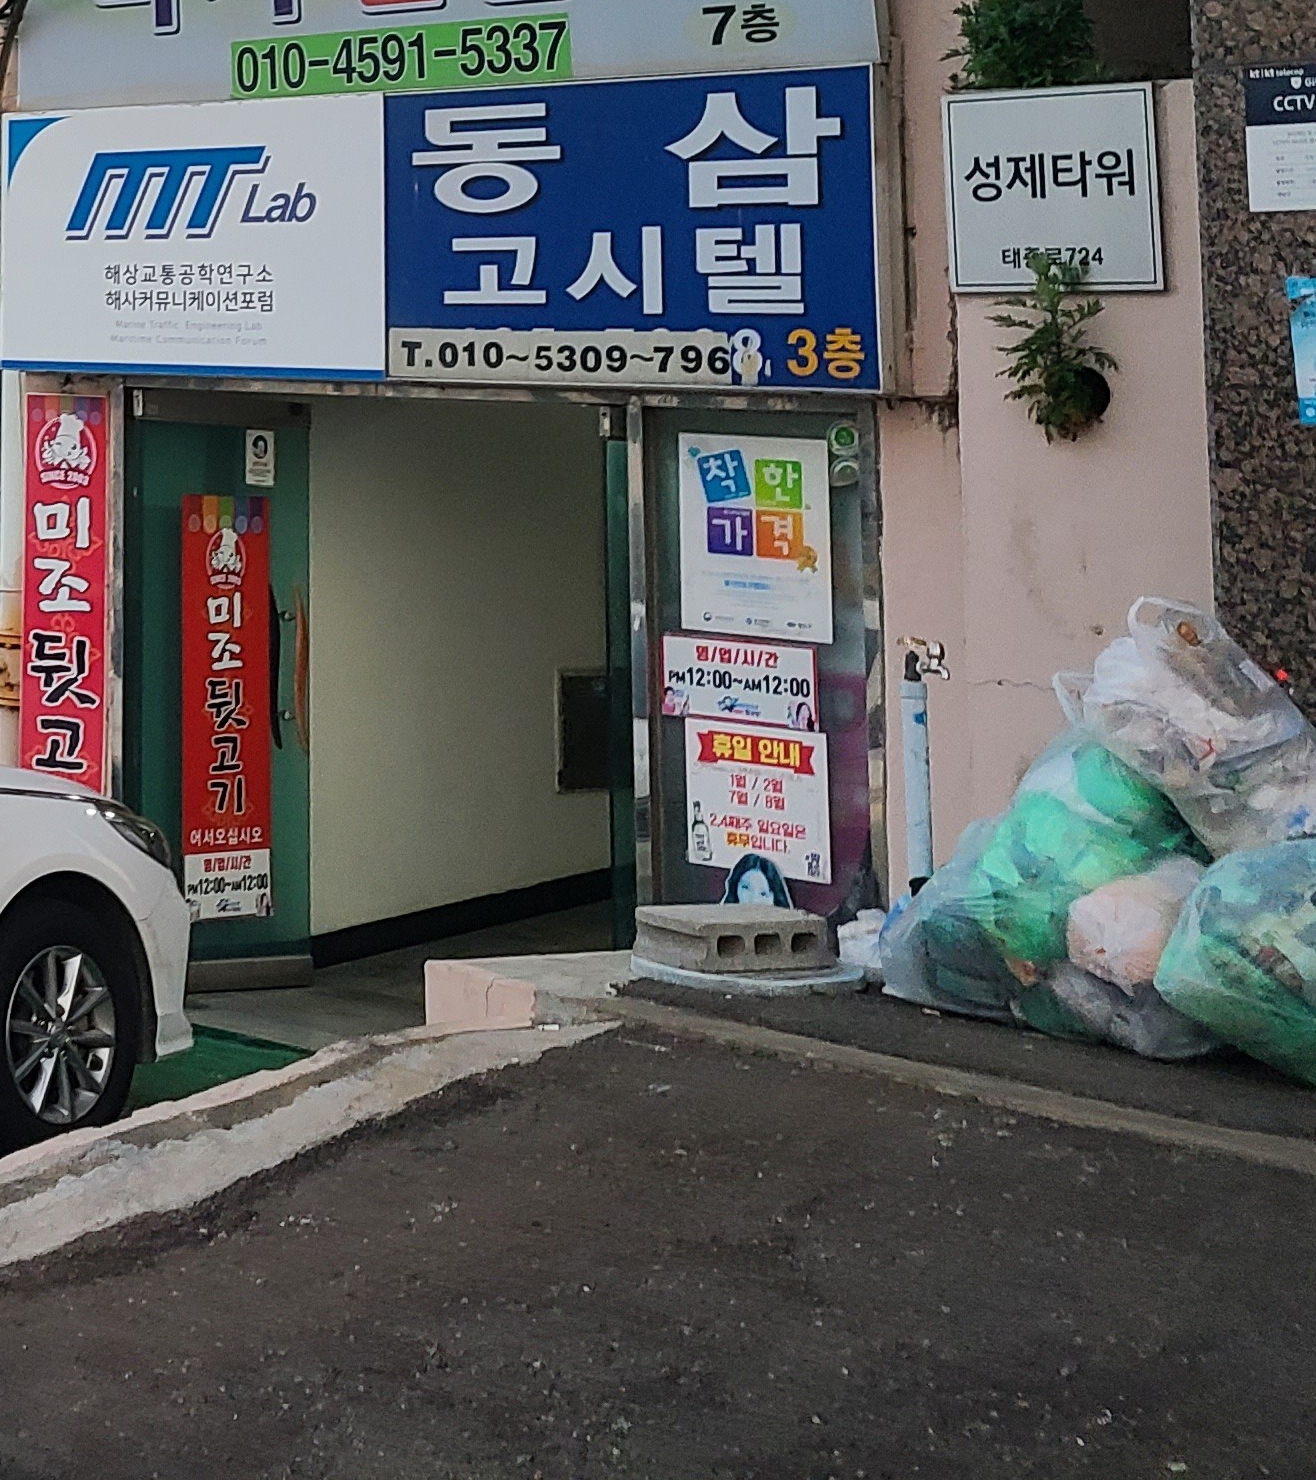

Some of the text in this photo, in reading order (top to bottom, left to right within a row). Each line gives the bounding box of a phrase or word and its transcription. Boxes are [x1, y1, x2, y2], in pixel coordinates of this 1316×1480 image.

[701, 3, 780, 47] 7층
[235, 20, 567, 93] 010-4591-5337
[1273, 93, 1316, 112] CCTV
[964, 148, 1136, 203] 성제타워
[240, 181, 317, 223] Lab
[104, 262, 274, 286] 해상교통공학연구소
[444, 223, 806, 317] 고시텔
[105, 289, 274, 313] 해사커뮤니케이션포럼
[787, 327, 865, 379] 3층
[712, 733, 800, 768] 휴일 안내
[729, 790, 748, 806] 7월
[730, 773, 747, 789] 1월
[763, 777, 783, 794] 2월
[190, 826, 263, 847] 어서오십시오
